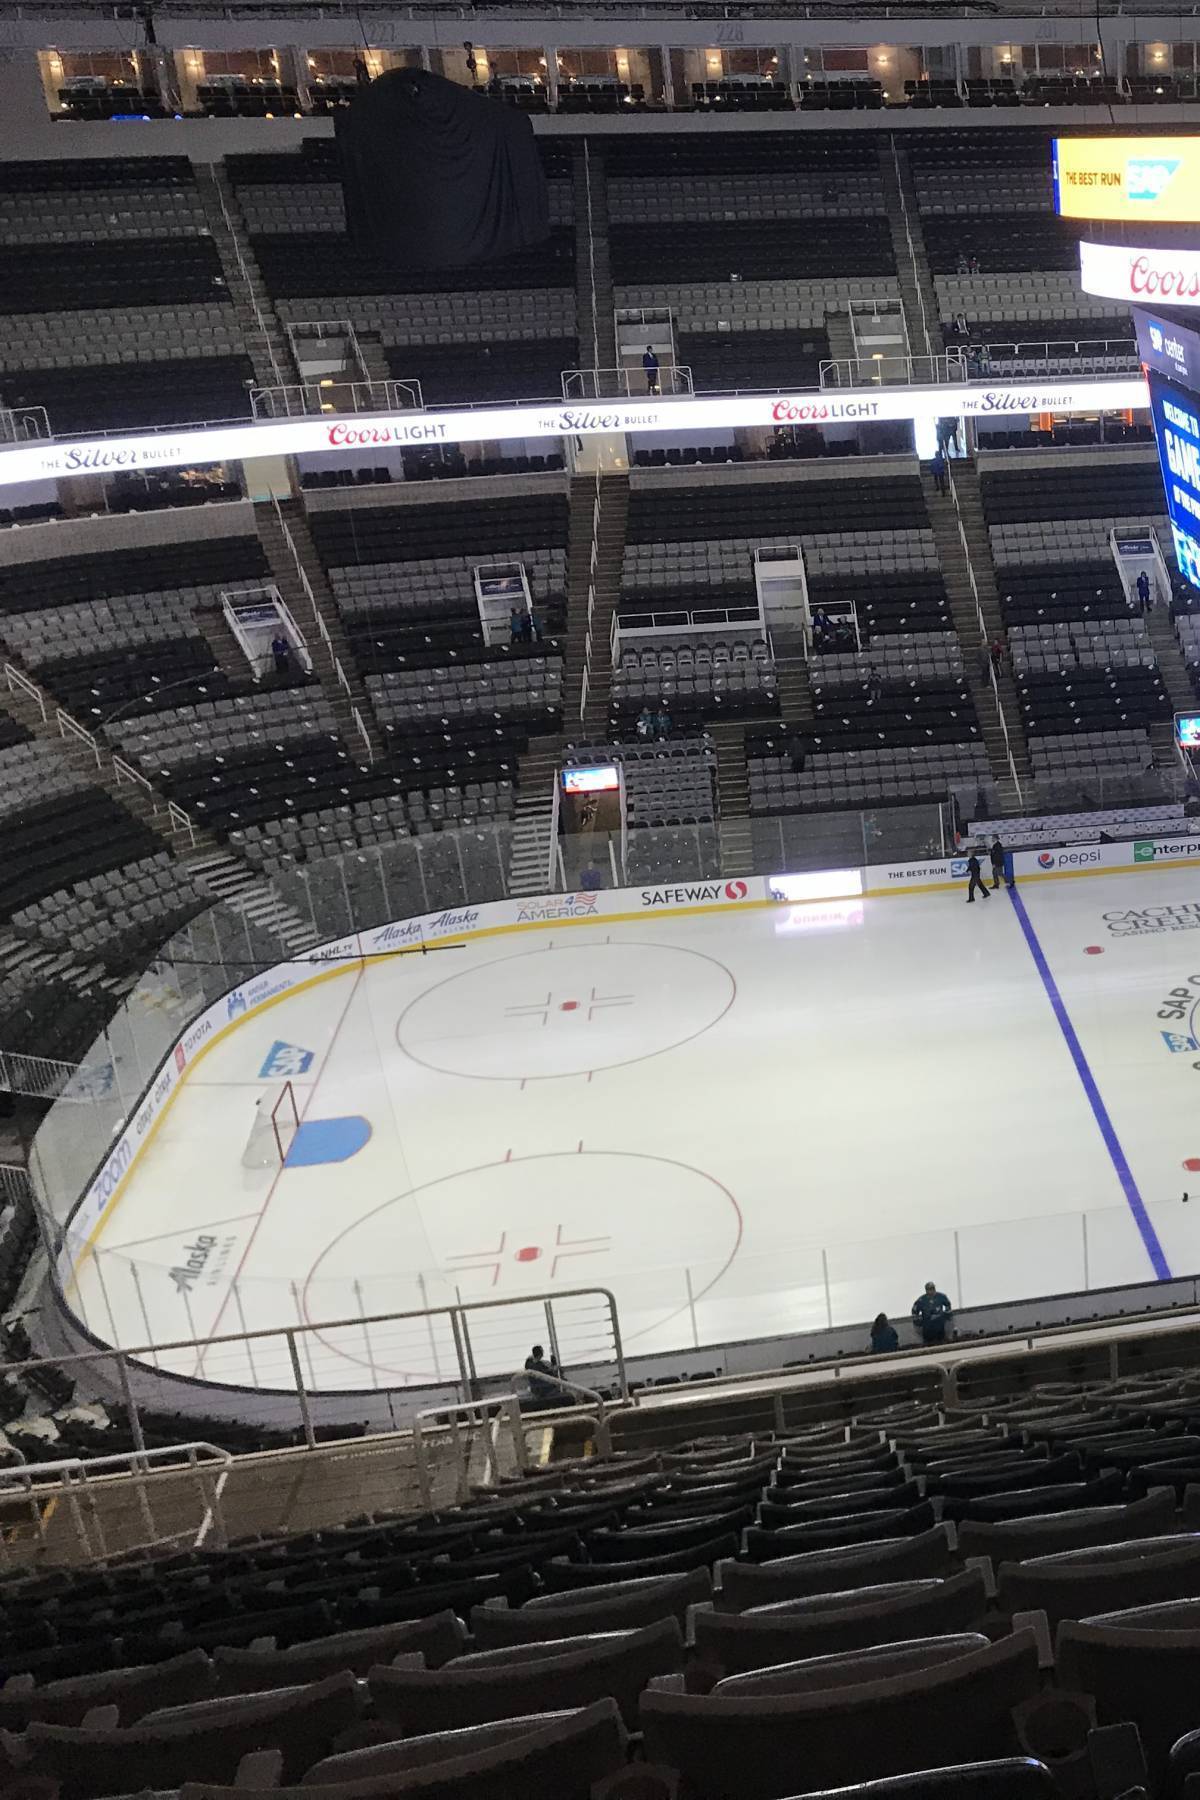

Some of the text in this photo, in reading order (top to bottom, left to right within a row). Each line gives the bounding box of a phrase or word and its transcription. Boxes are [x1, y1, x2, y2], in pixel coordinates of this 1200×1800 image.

[1066, 171, 1121, 186] THE BEST RUN
[1130, 256, 1199, 297] Coors
[771, 399, 879, 421] Coors LIGHT
[962, 392, 1073, 412] THE Silver BULLET
[538, 410, 659, 431] THE Silver BULLET
[326, 423, 446, 446] Coors LIGHT
[40, 447, 182, 470] THE Silver BULLET
[1058, 848, 1101, 868] pepsi
[888, 867, 947, 879] THE BEST RUN
[641, 885, 721, 906] SAFEWAY
[429, 910, 480, 930] Alaska
[516, 905, 599, 922] AMERICA
[372, 922, 422, 944] Alaska
[1156, 986, 1194, 1020] SAP
[168, 1235, 217, 1294] Alaska
